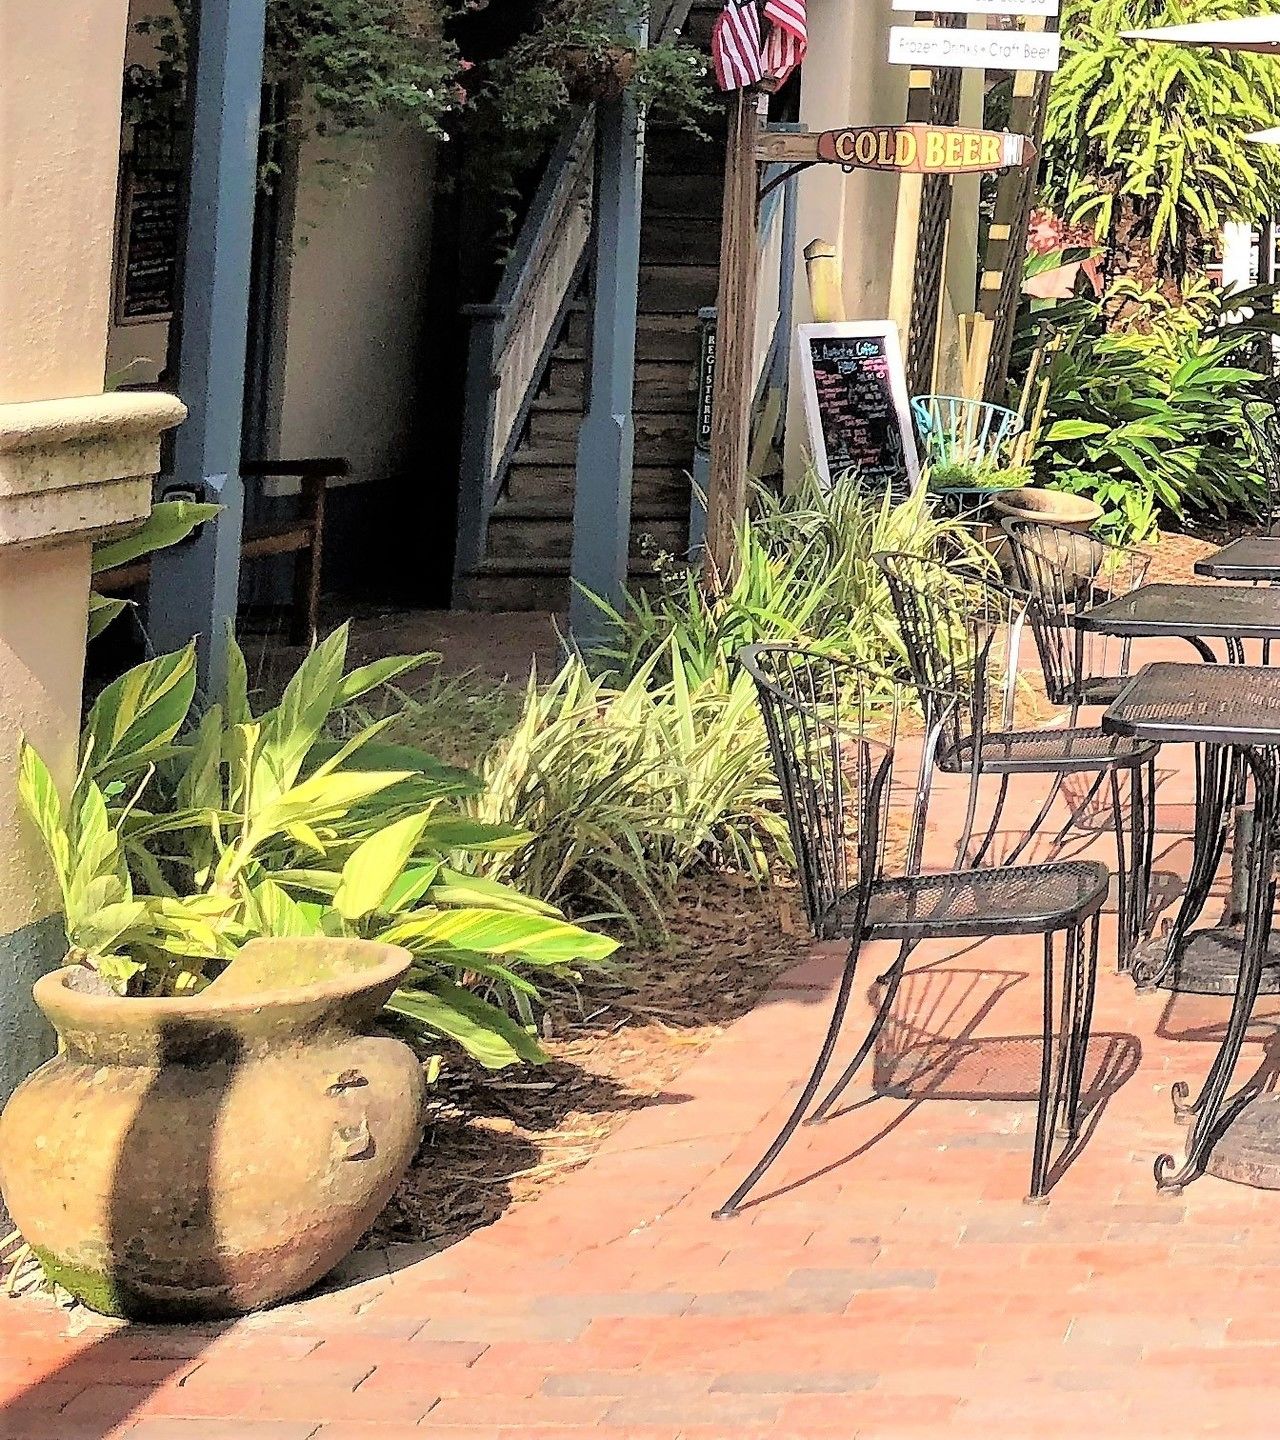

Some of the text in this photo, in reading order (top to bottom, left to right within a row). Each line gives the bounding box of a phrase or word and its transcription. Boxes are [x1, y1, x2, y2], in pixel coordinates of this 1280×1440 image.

[835, 130, 1001, 167] COLD BEER
[702, 335, 715, 434] REGISTERED
